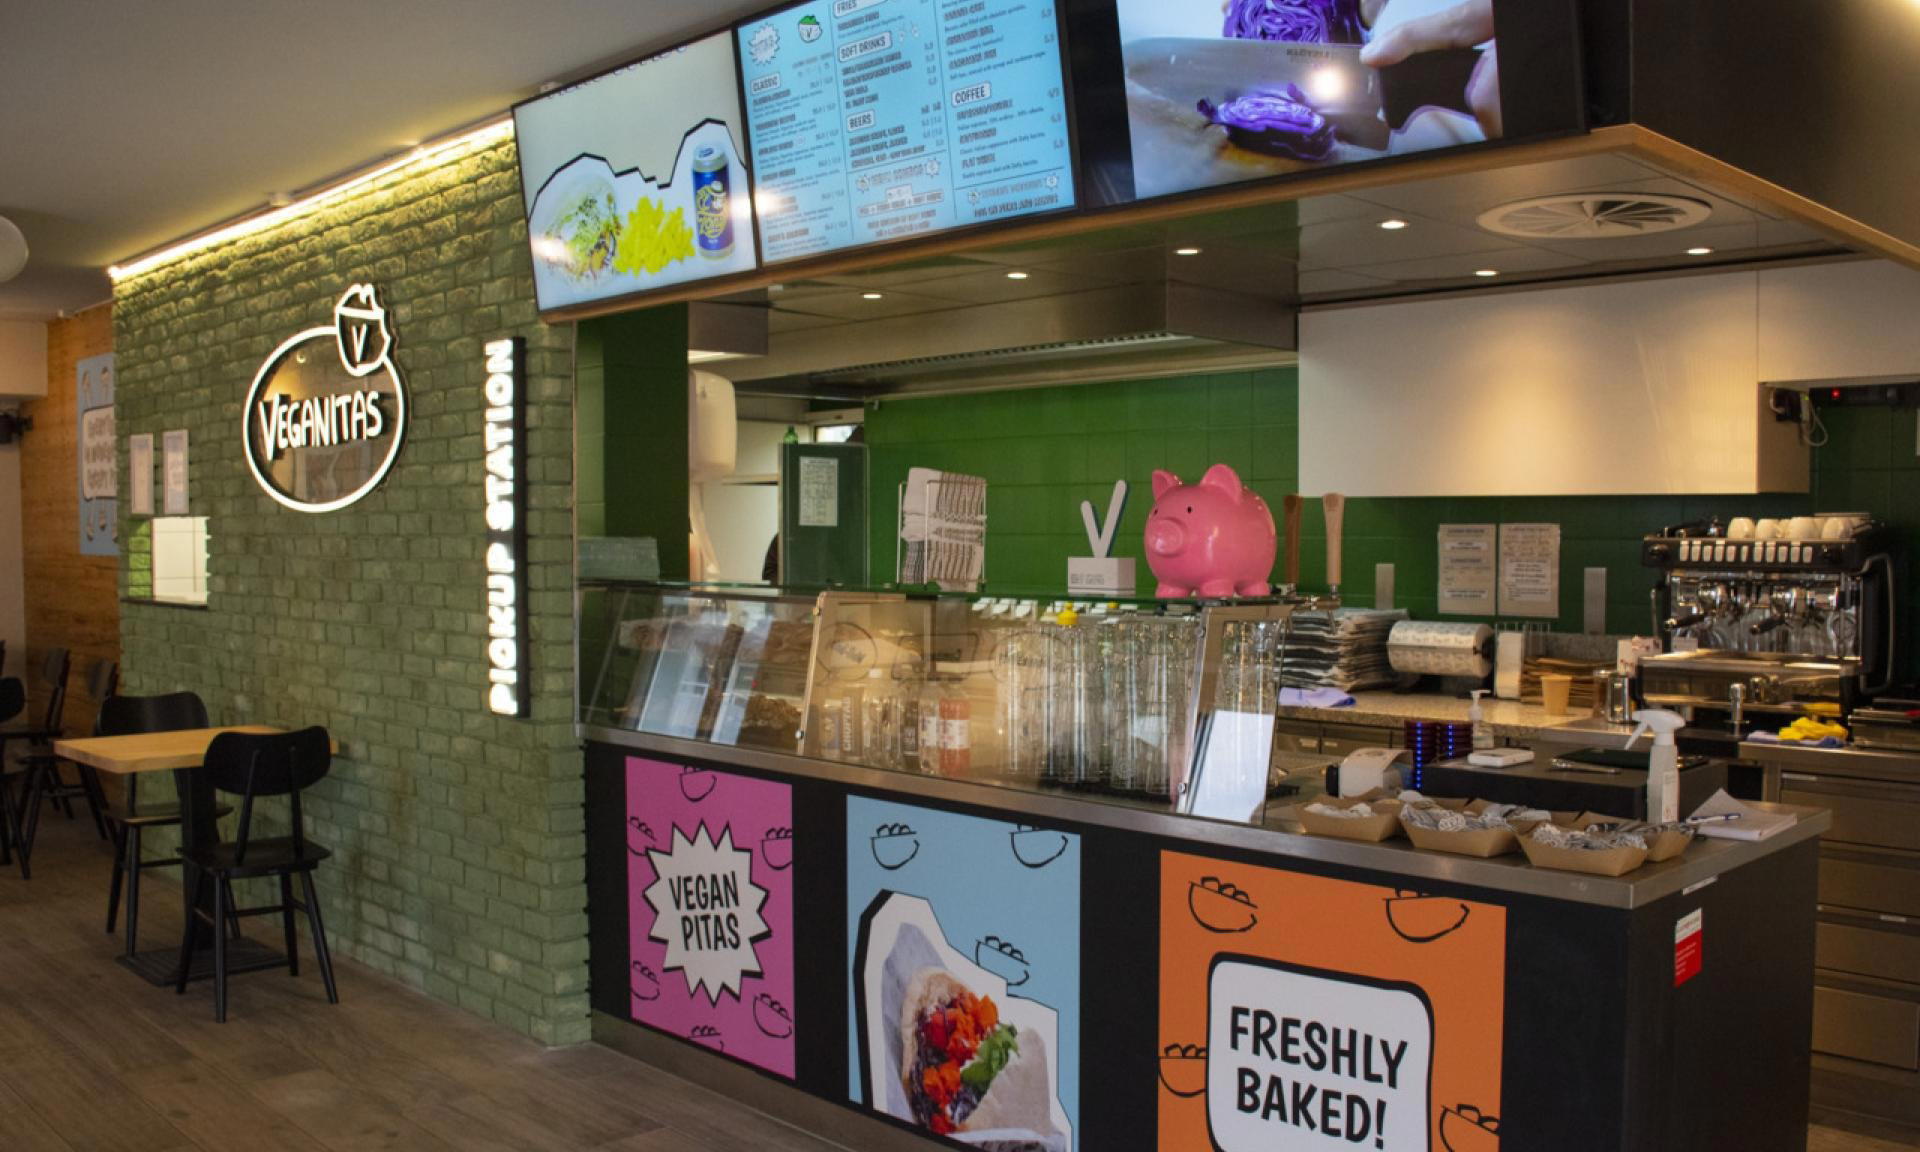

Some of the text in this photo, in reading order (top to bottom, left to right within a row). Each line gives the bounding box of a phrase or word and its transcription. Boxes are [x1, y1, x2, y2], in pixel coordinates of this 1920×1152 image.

[836, 0, 857, 14] FRIES
[840, 36, 886, 59] SOFT DRINKS
[752, 76, 779, 92] CLASSIC
[955, 86, 985, 104] COFFEE
[849, 114, 872, 129] BEERS
[258, 390, 383, 462] VEGANITAS
[485, 339, 518, 715] PICKUP STATION
[669, 870, 739, 911] VEGAN
[680, 912, 741, 952] PITAS
[1230, 1005, 1408, 1089] FRESHLY
[1237, 1067, 1387, 1150] BAKED!
